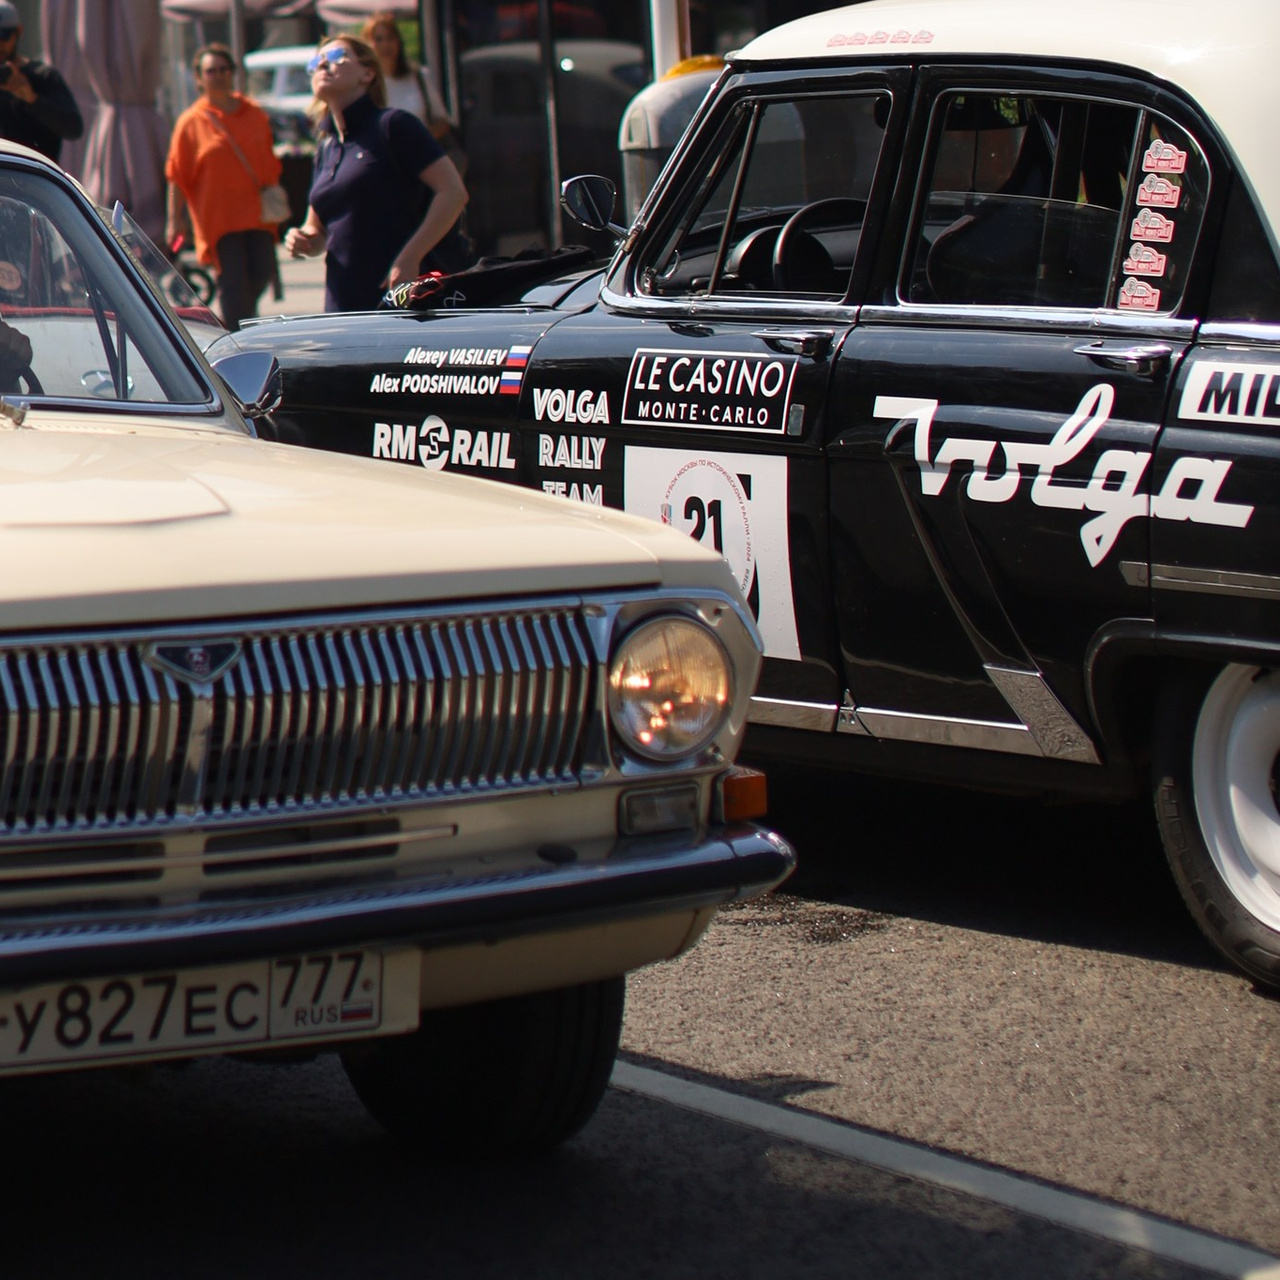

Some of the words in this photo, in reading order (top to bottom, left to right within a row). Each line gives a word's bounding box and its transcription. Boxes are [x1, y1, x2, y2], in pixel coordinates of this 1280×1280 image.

[403, 346, 448, 368] Alexey
[448, 348, 508, 366] VASILIEV
[370, 373, 401, 393] Alex
[401, 373, 500, 395] PODSHIVALOV
[634, 355, 668, 391] LE
[668, 357, 785, 398] CASINO
[532, 387, 610, 424] VOLGA
[372, 422, 418, 461] RM
[450, 428, 516, 470] RAIL
[538, 433, 607, 470] RALLY
[698, 459, 708, 467] ПО
[683, 495, 724, 557] 21
[275, 951, 364, 1008] 777
[294, 1004, 338, 1027] RUS
